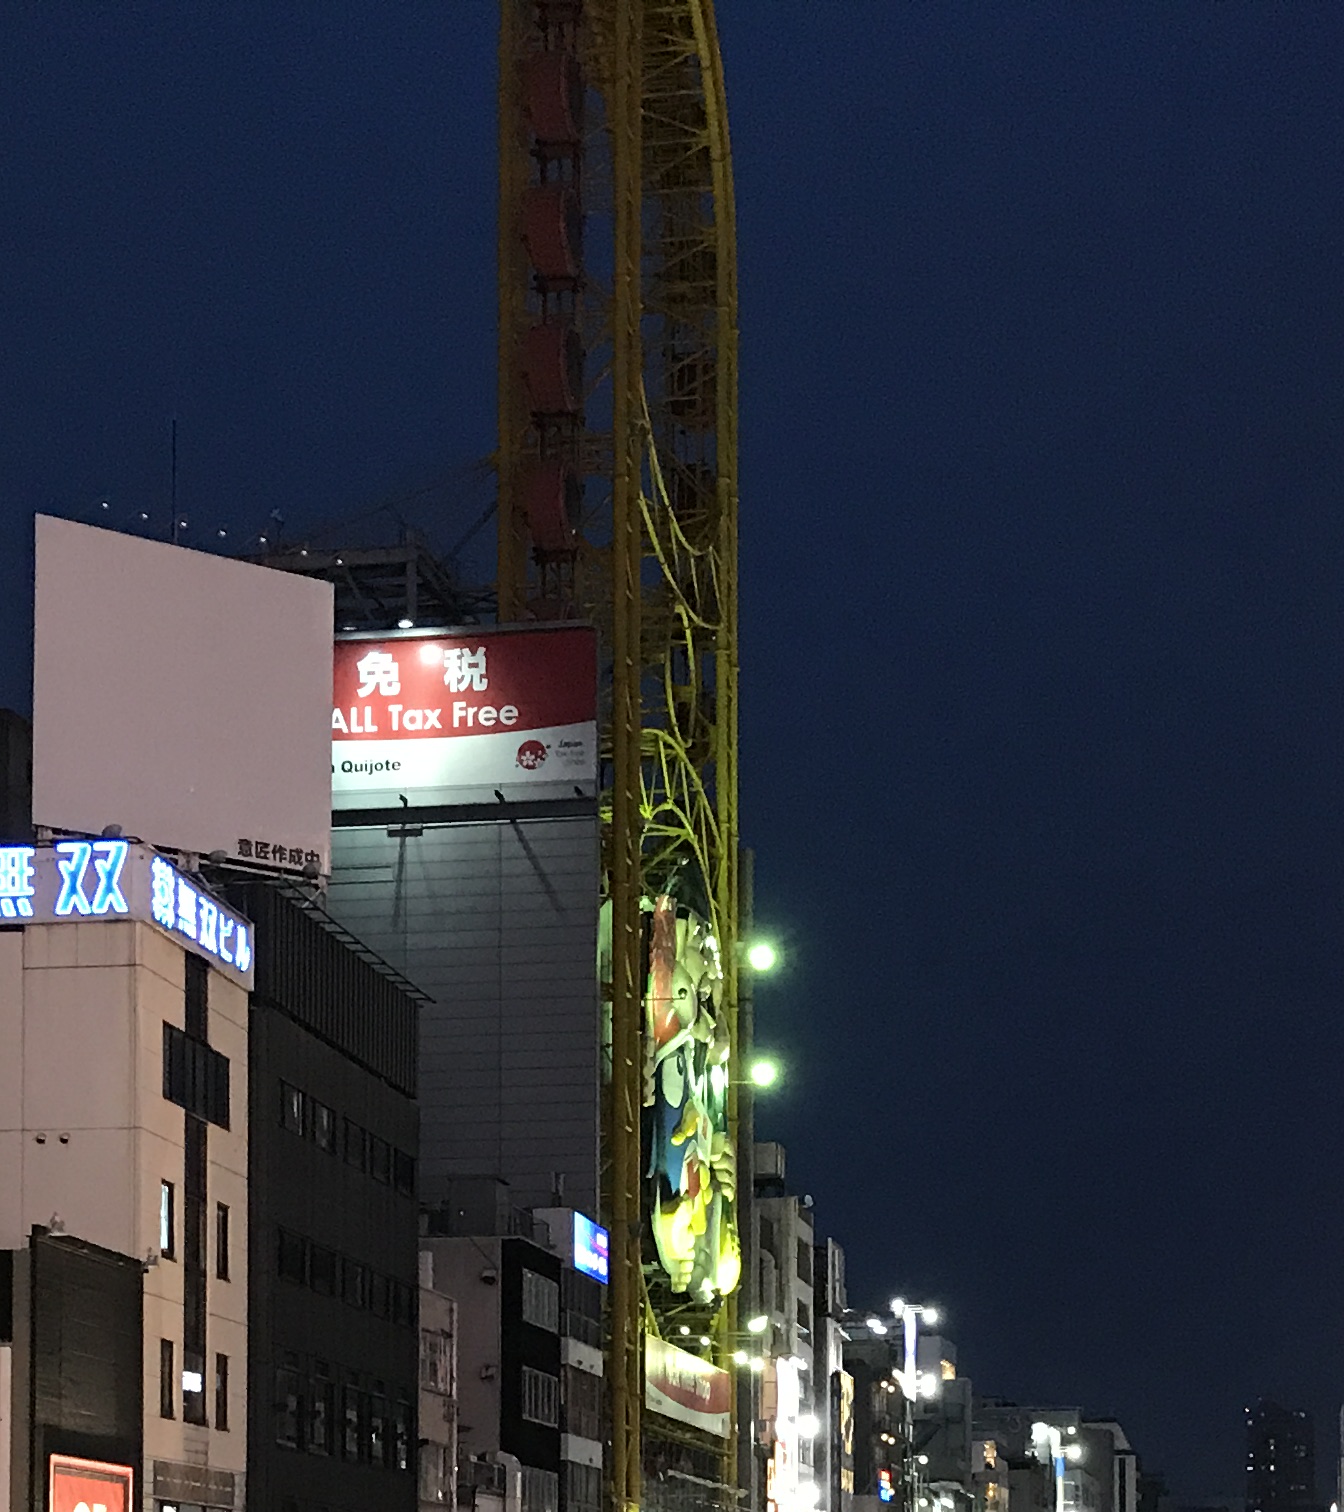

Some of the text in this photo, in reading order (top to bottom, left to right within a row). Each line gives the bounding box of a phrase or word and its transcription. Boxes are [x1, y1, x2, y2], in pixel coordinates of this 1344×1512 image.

[356, 646, 489, 698] 免税
[332, 701, 519, 734] ALL Tax Free
[340, 759, 402, 776] Quijote
[236, 837, 320, 869] 意匠作成中
